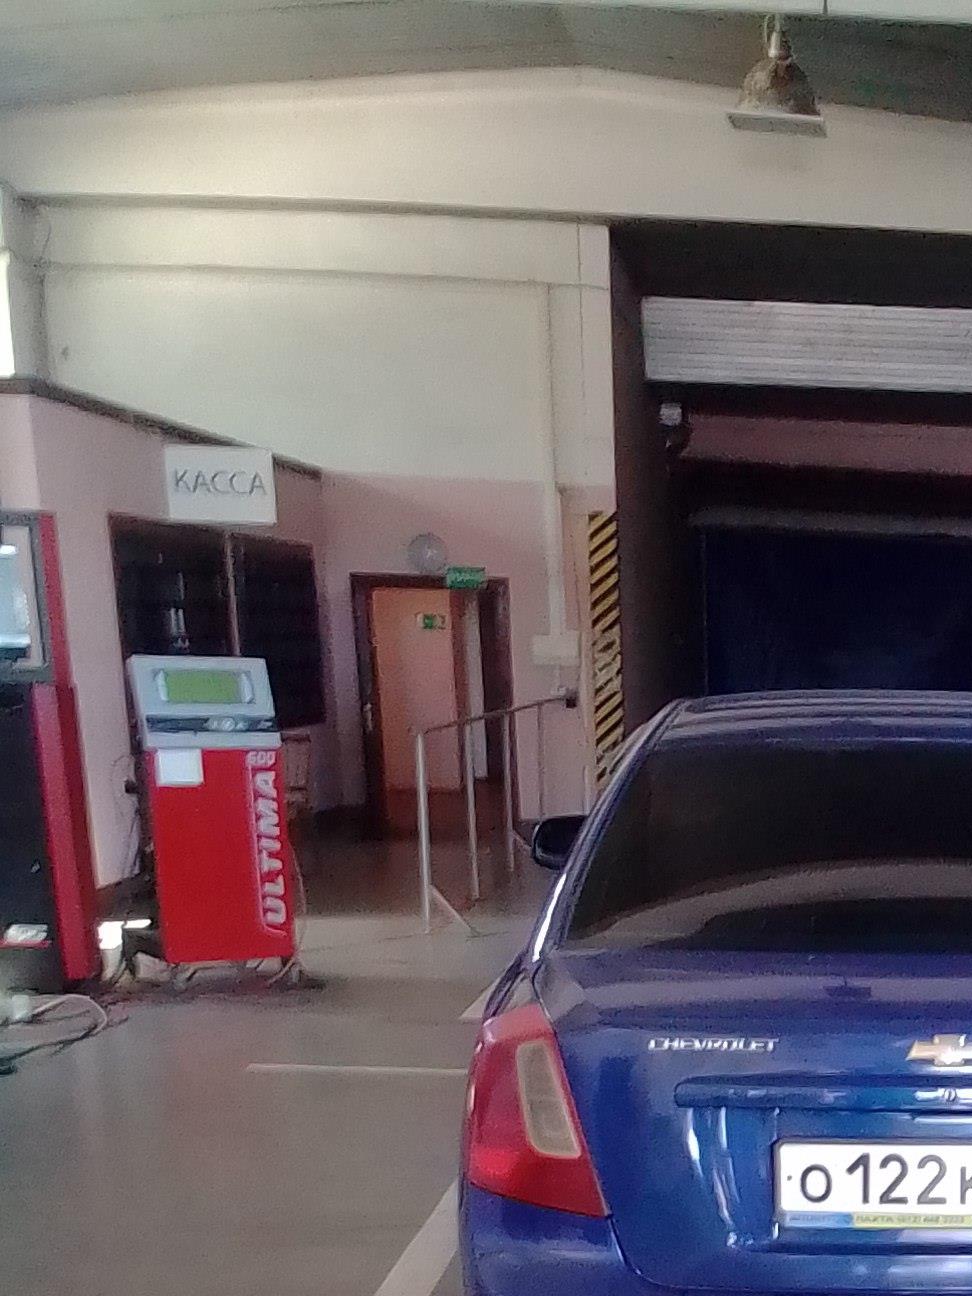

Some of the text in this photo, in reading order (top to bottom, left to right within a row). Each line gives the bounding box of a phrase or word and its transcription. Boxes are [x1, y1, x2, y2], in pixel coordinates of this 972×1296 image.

[174, 468, 267, 495] КАССА
[254, 770, 287, 926] ULTIMA
[648, 1037, 780, 1052] CHEVROLET
